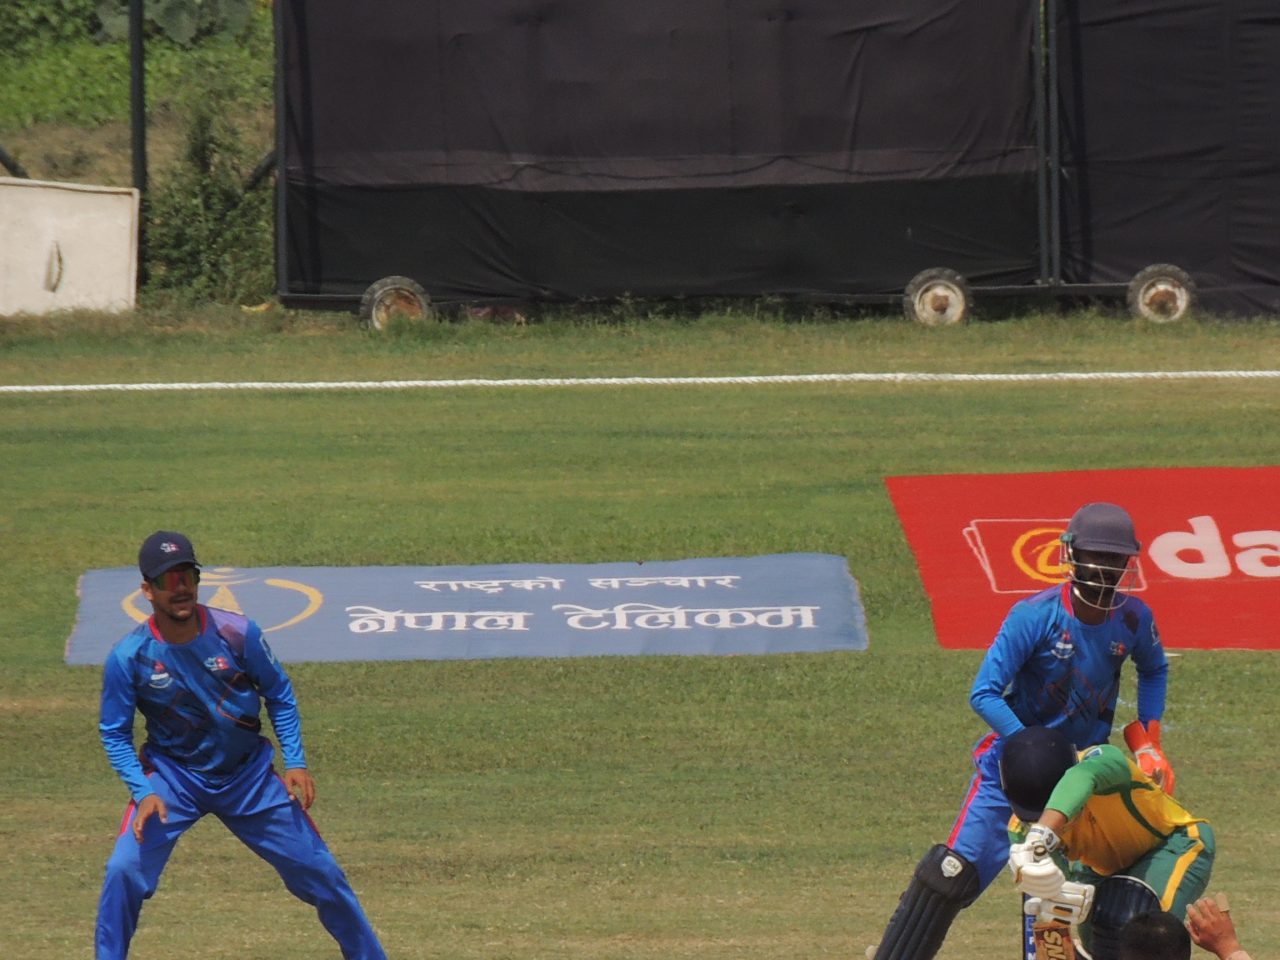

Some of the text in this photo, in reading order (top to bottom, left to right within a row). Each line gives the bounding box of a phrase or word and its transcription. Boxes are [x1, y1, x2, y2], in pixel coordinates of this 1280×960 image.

[414, 576, 566, 594] राष्ट्रको
[345, 602, 821, 633] नेपाल टेलिकम
